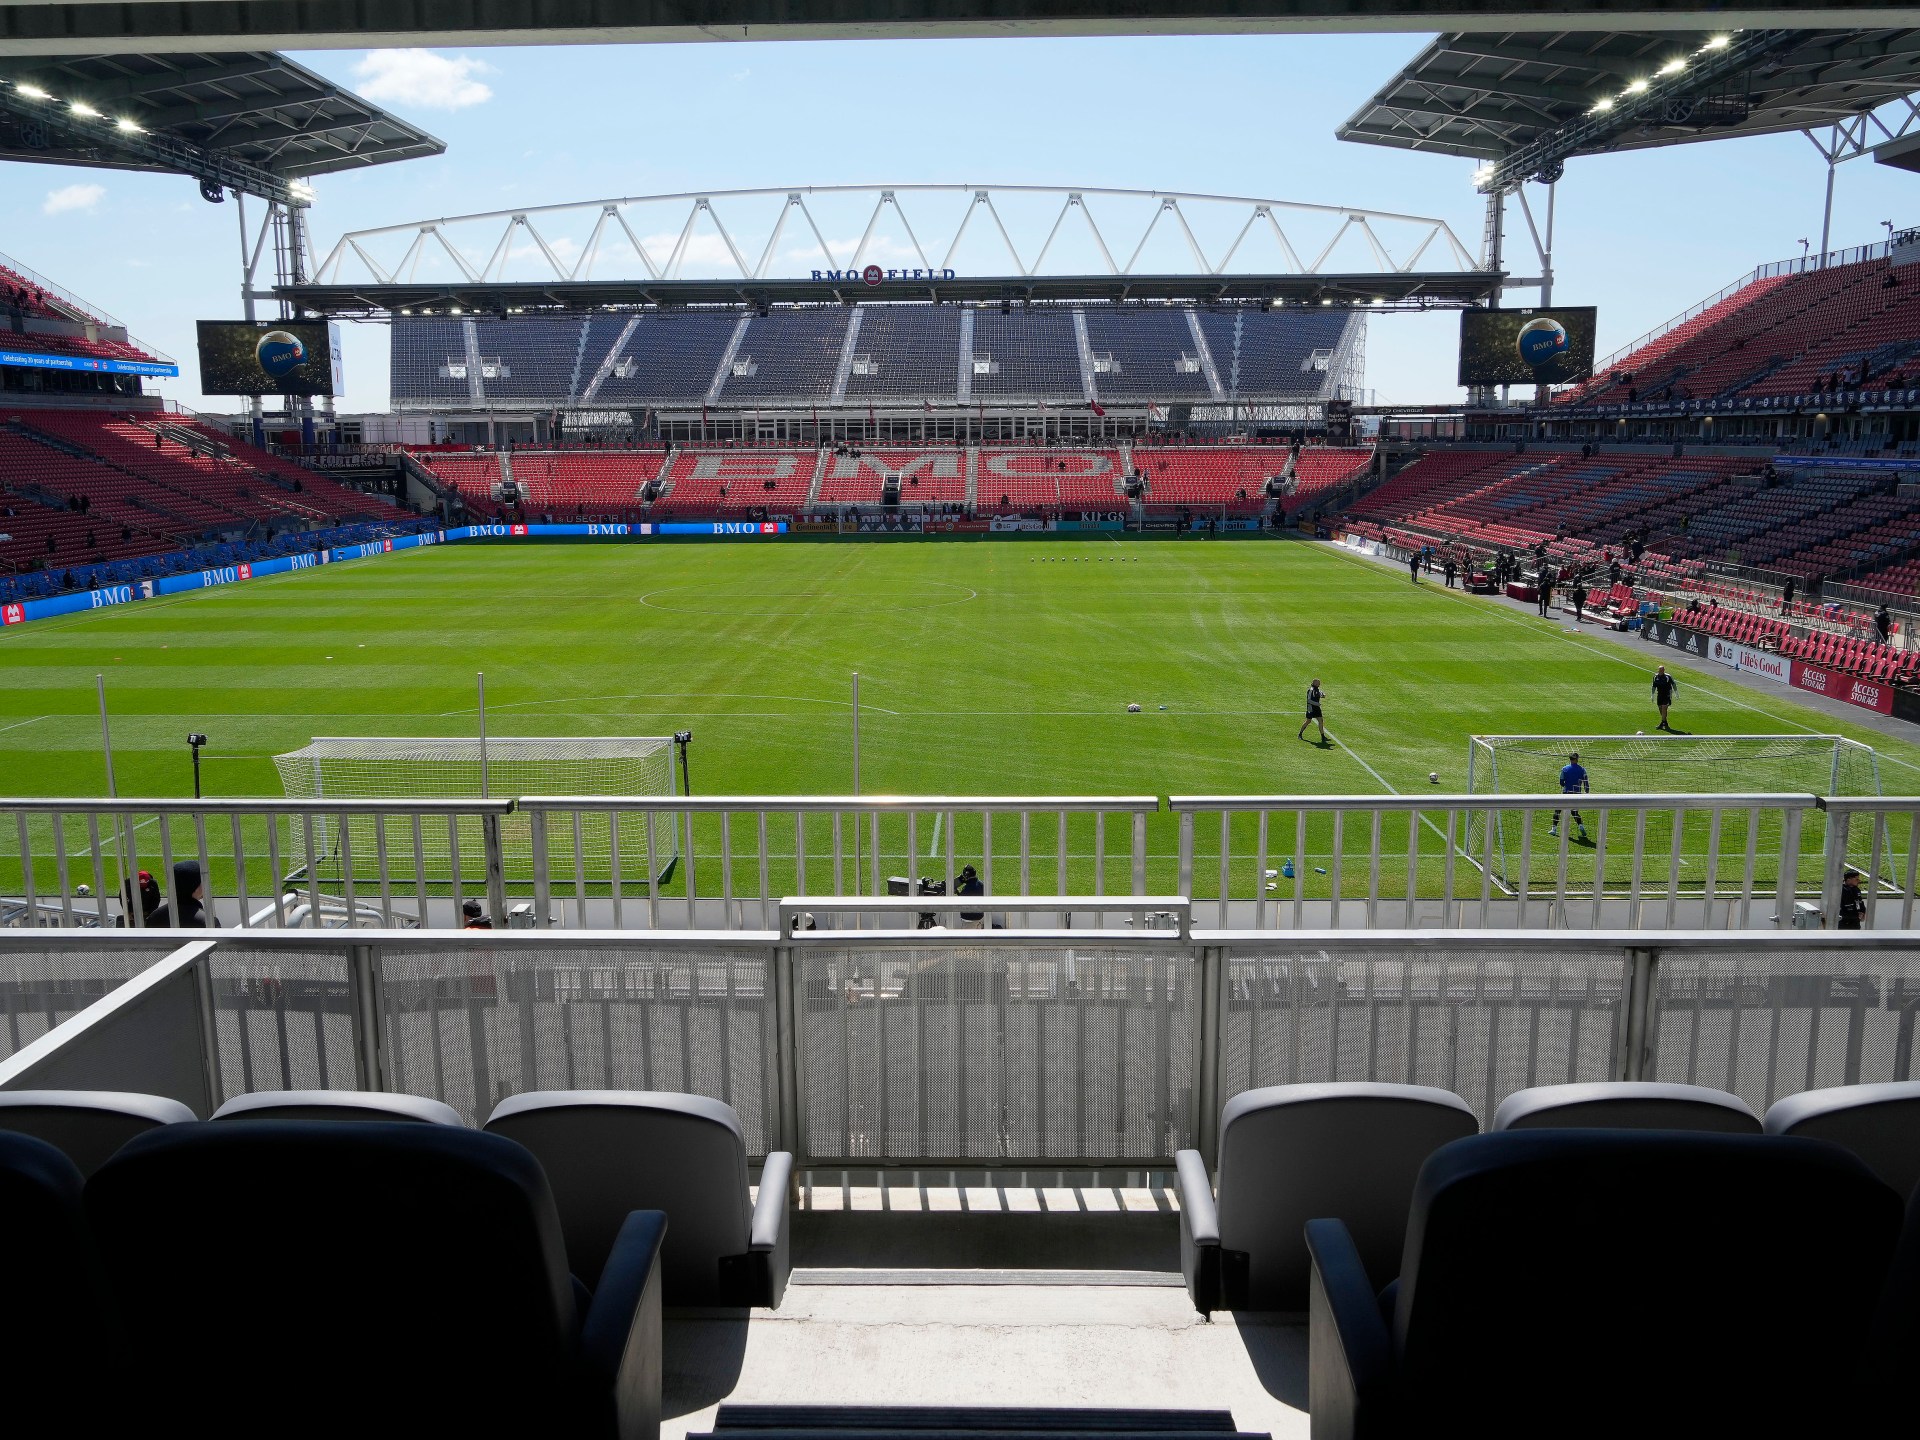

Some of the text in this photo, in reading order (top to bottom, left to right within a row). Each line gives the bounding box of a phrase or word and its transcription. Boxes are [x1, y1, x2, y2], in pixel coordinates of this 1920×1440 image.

[811, 268, 956, 282] BMO FIELD
[1532, 340, 1553, 351] BMO
[272, 352, 292, 363] BMO
[319, 453, 384, 466] FORTRESS
[686, 453, 1112, 479] BMO
[469, 525, 505, 537] BMO
[588, 524, 628, 535] BMO
[713, 523, 754, 534] BMO
[418, 532, 436, 546] BMO
[360, 541, 382, 557] BMO
[291, 554, 315, 571] BMO
[203, 566, 235, 587] BMO
[90, 586, 132, 609] BMO
[1647, 632, 1660, 641] adidas
[1666, 638, 1679, 647] adidas
[1685, 644, 1699, 653] adidas
[1723, 646, 1733, 659] LG
[1739, 651, 1784, 679] Life's Good.
[1802, 667, 1827, 683] ACCESS
[1801, 677, 1826, 691] STORAGE
[1852, 681, 1879, 698] ACCESS
[1851, 692, 1878, 707] STORAGE
